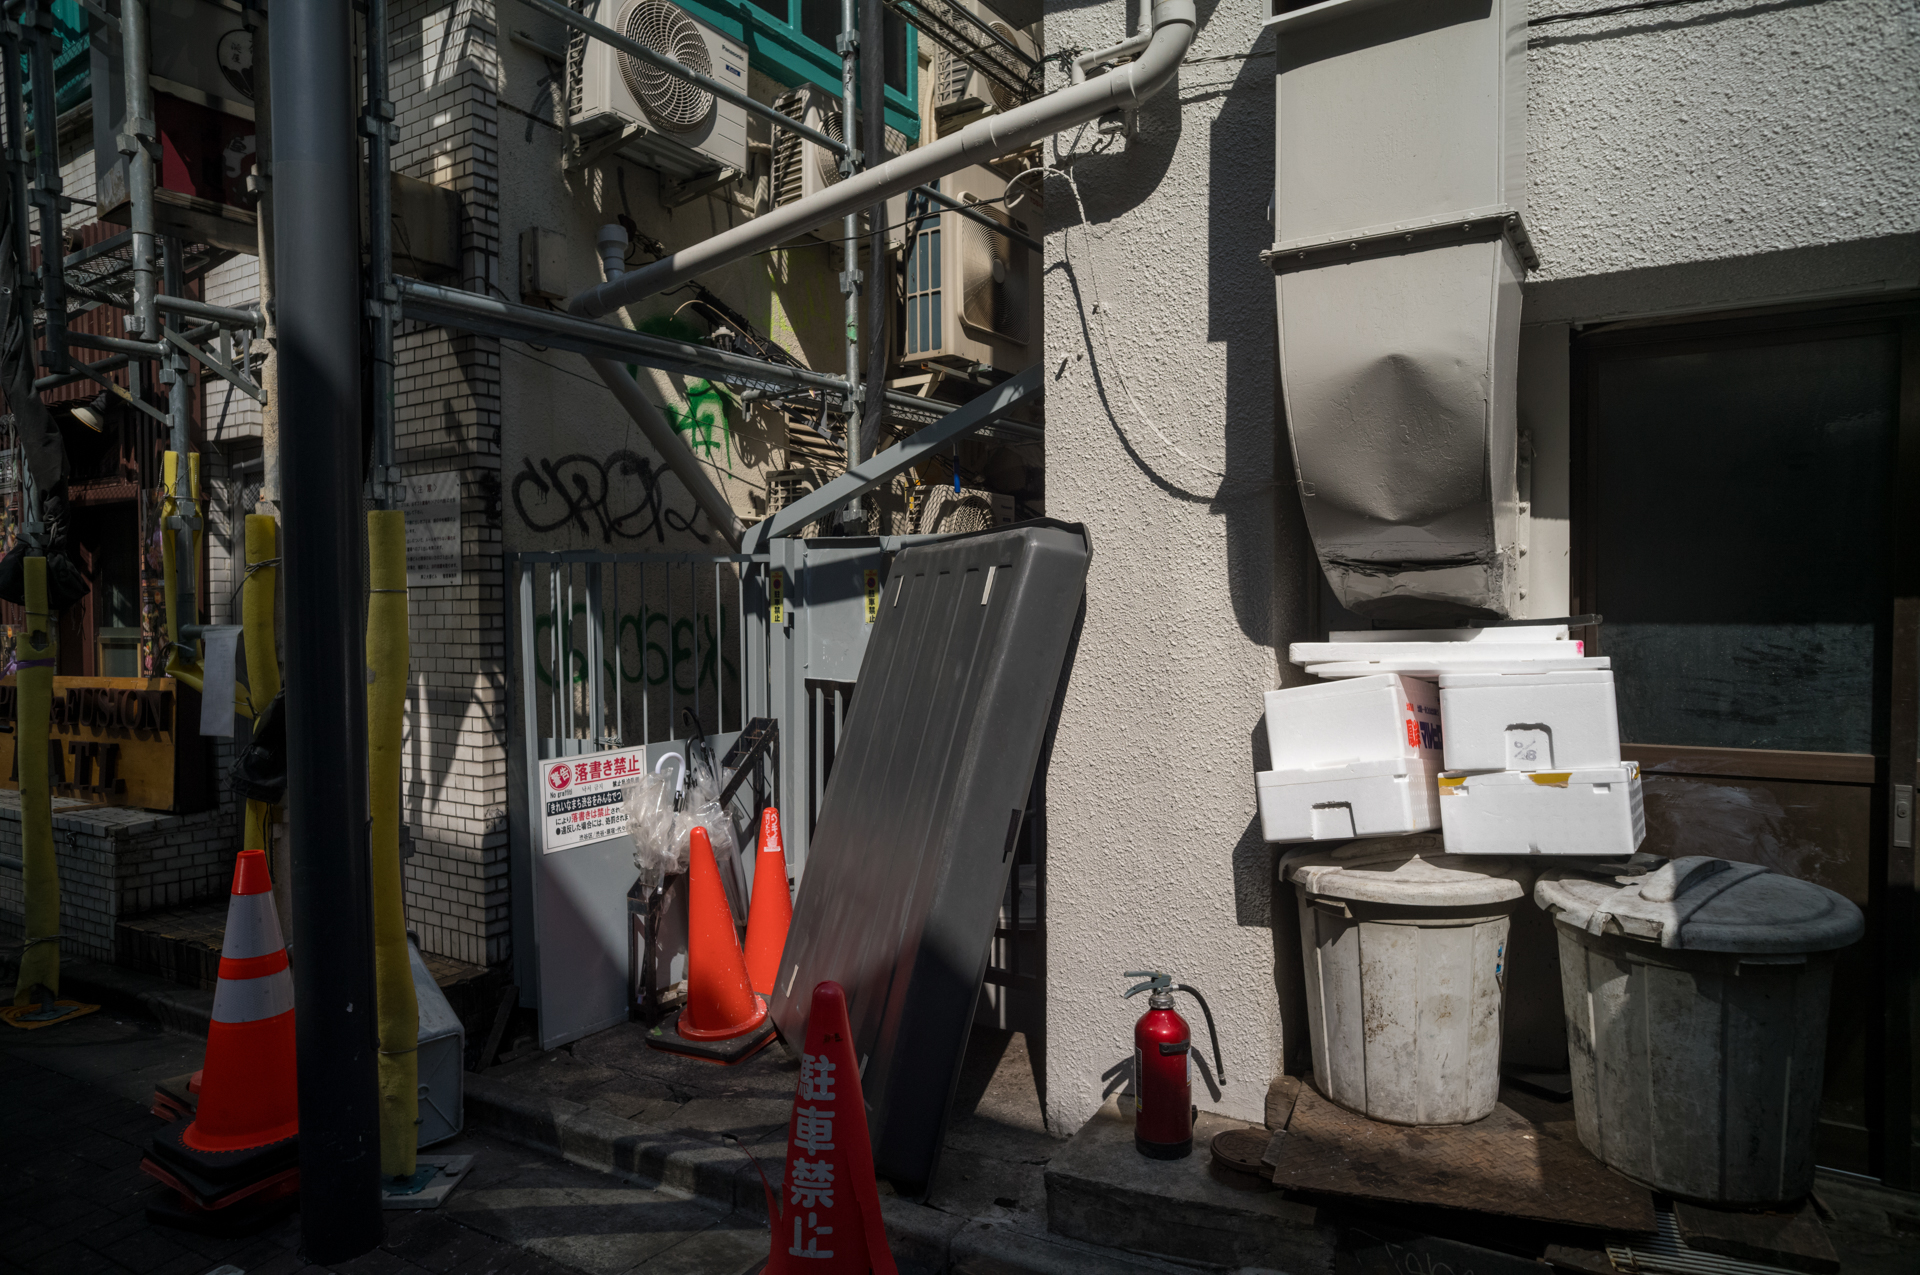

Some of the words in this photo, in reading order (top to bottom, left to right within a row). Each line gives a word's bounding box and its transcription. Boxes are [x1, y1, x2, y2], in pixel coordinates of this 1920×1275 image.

[65, 687, 172, 732] FUSION
[575, 755, 640, 782] 落書き禁止
[788, 1053, 837, 1260] 駐車禁止
